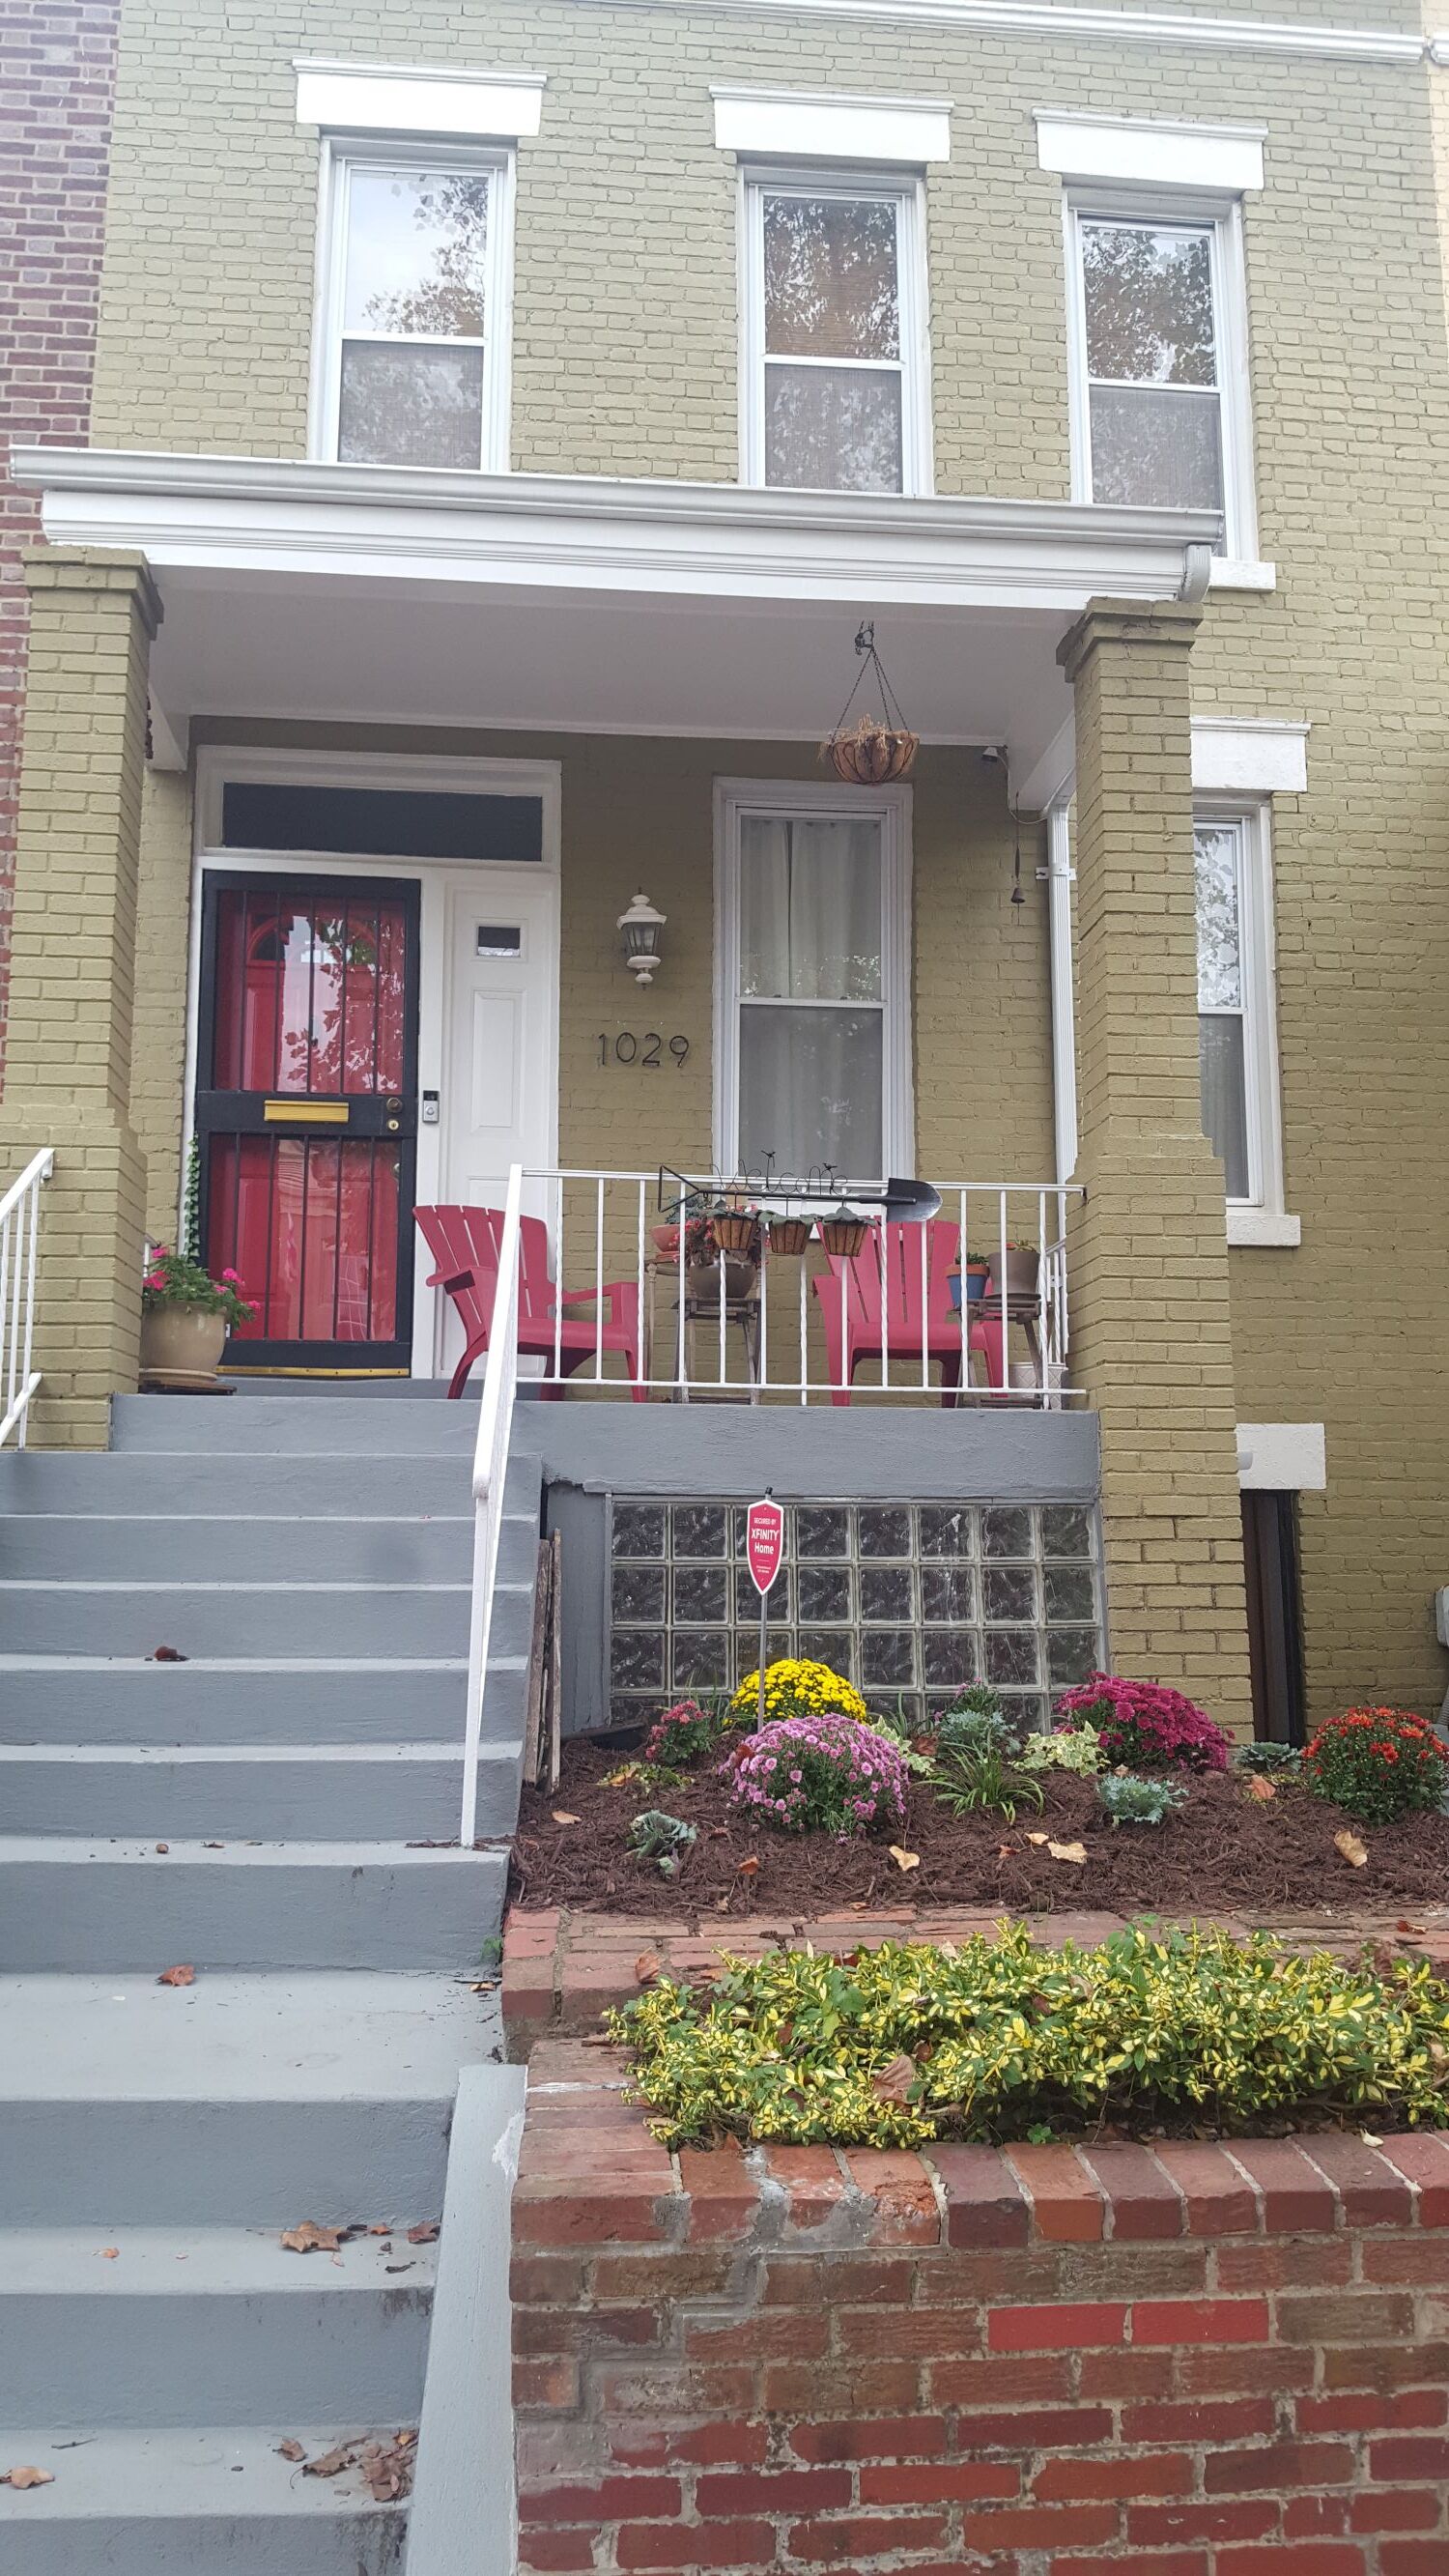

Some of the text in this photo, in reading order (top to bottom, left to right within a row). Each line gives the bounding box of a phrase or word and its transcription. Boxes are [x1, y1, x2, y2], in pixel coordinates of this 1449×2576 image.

[599, 1032, 689, 1067] 1029
[752, 1528, 780, 1541] XFINITY
[754, 1542, 774, 1555] Home
